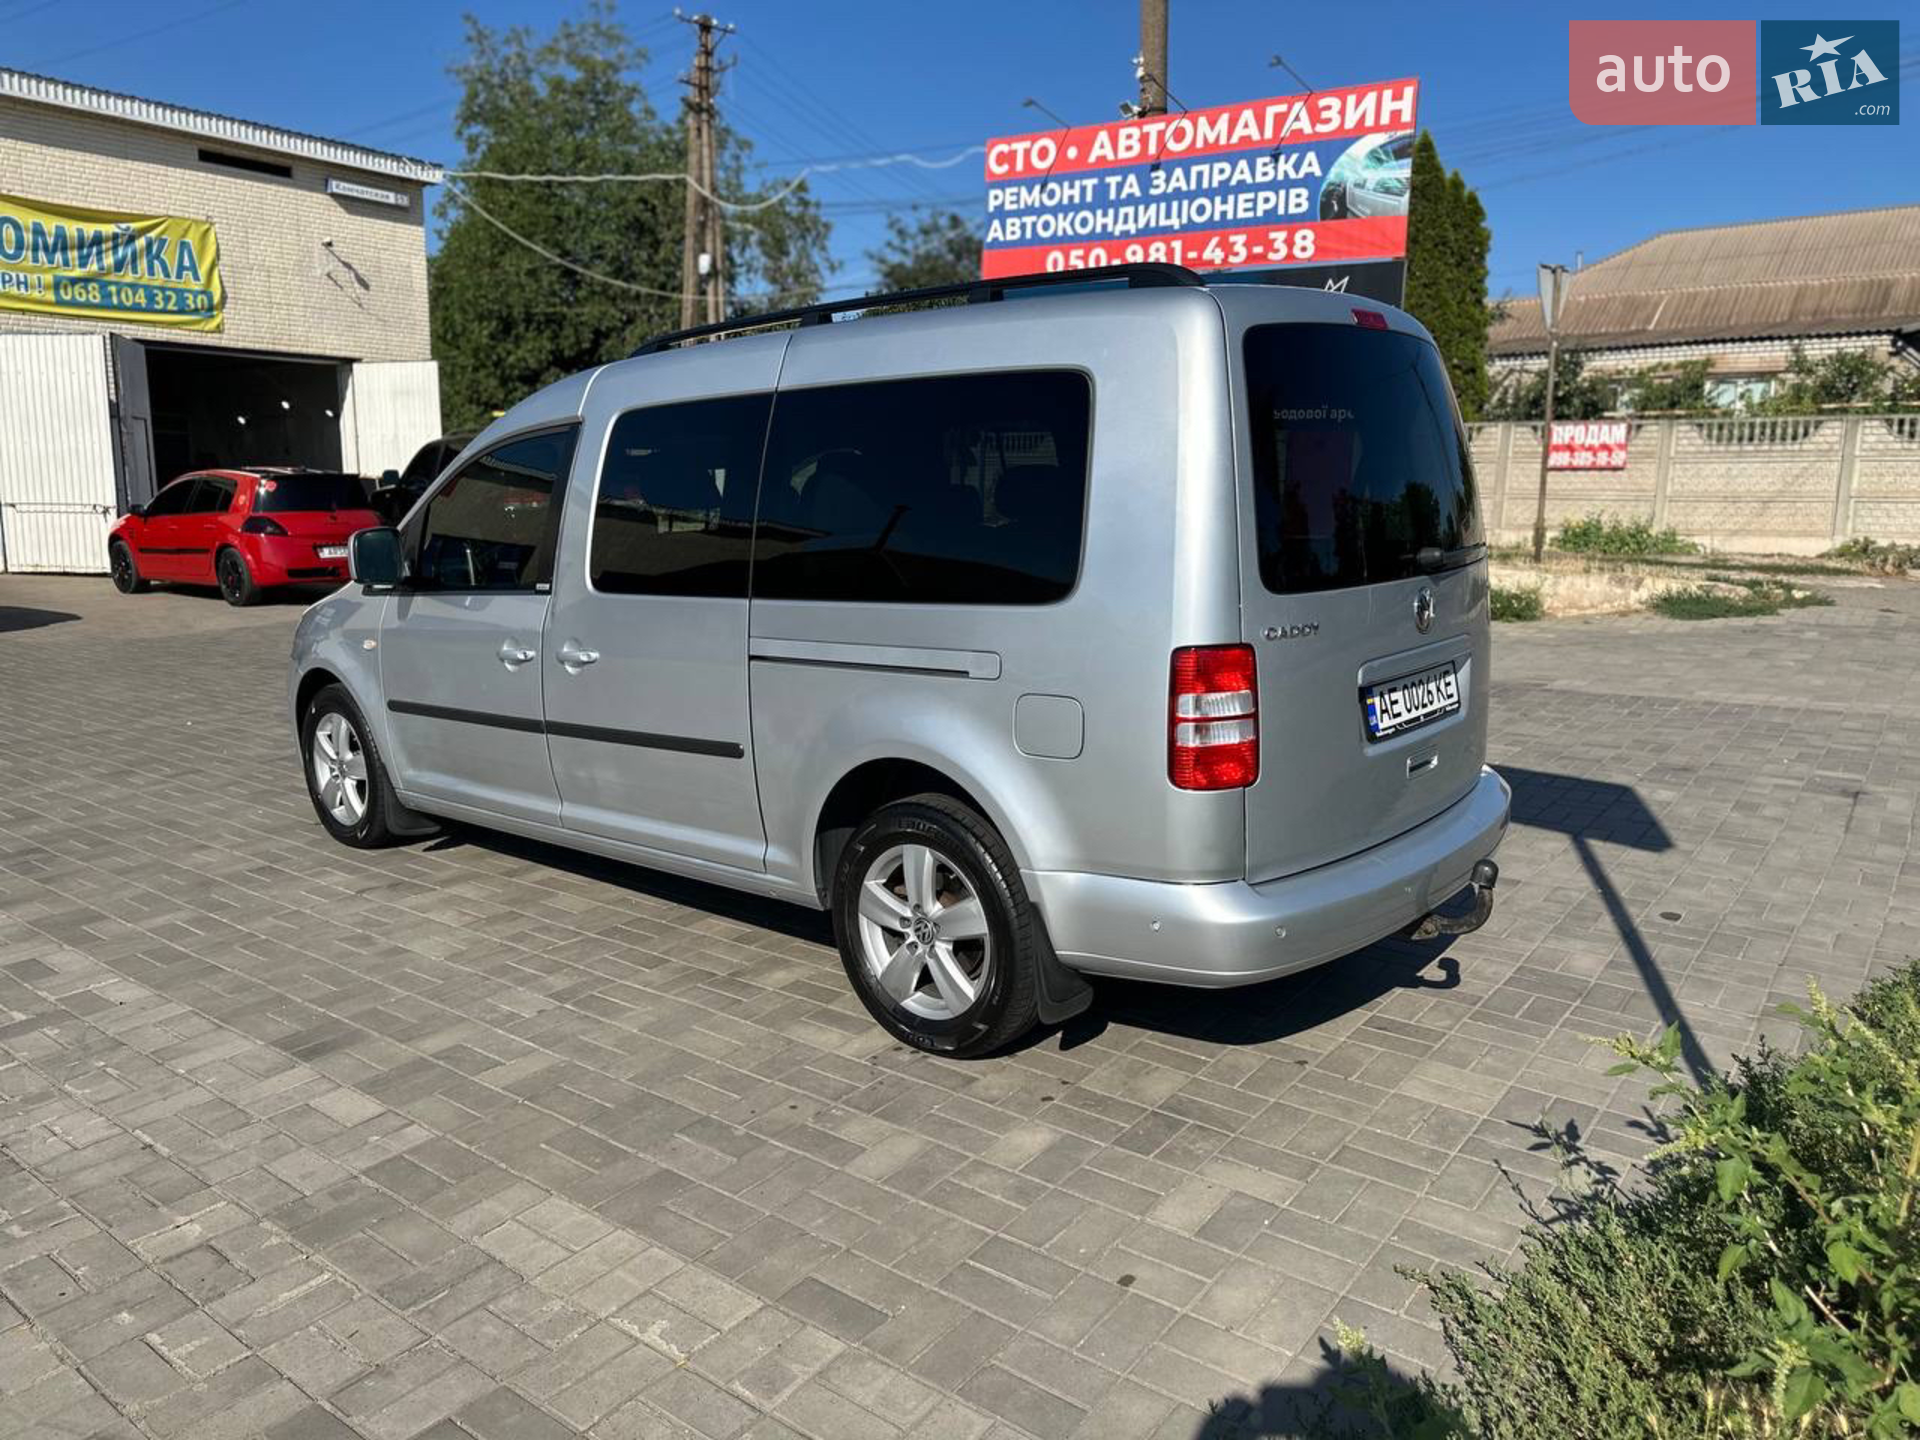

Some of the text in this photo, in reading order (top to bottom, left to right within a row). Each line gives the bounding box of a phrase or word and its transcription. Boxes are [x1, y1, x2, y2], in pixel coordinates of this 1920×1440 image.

[987, 85, 1415, 175] СТО АВТОМАГАЗИН
[987, 150, 1322, 212] РЕМОНТ ТА ЗАПРАВКА
[986, 186, 1310, 243] АВТОКОНДИЦІОНЕРІВ
[59, 279, 101, 303] 068
[107, 285, 147, 307] 104
[153, 289, 180, 310] 32
[1551, 423, 1627, 447] ПРОДАМ
[1265, 622, 1320, 641] CADDY
[1380, 669, 1454, 723] AE 0026 KE
